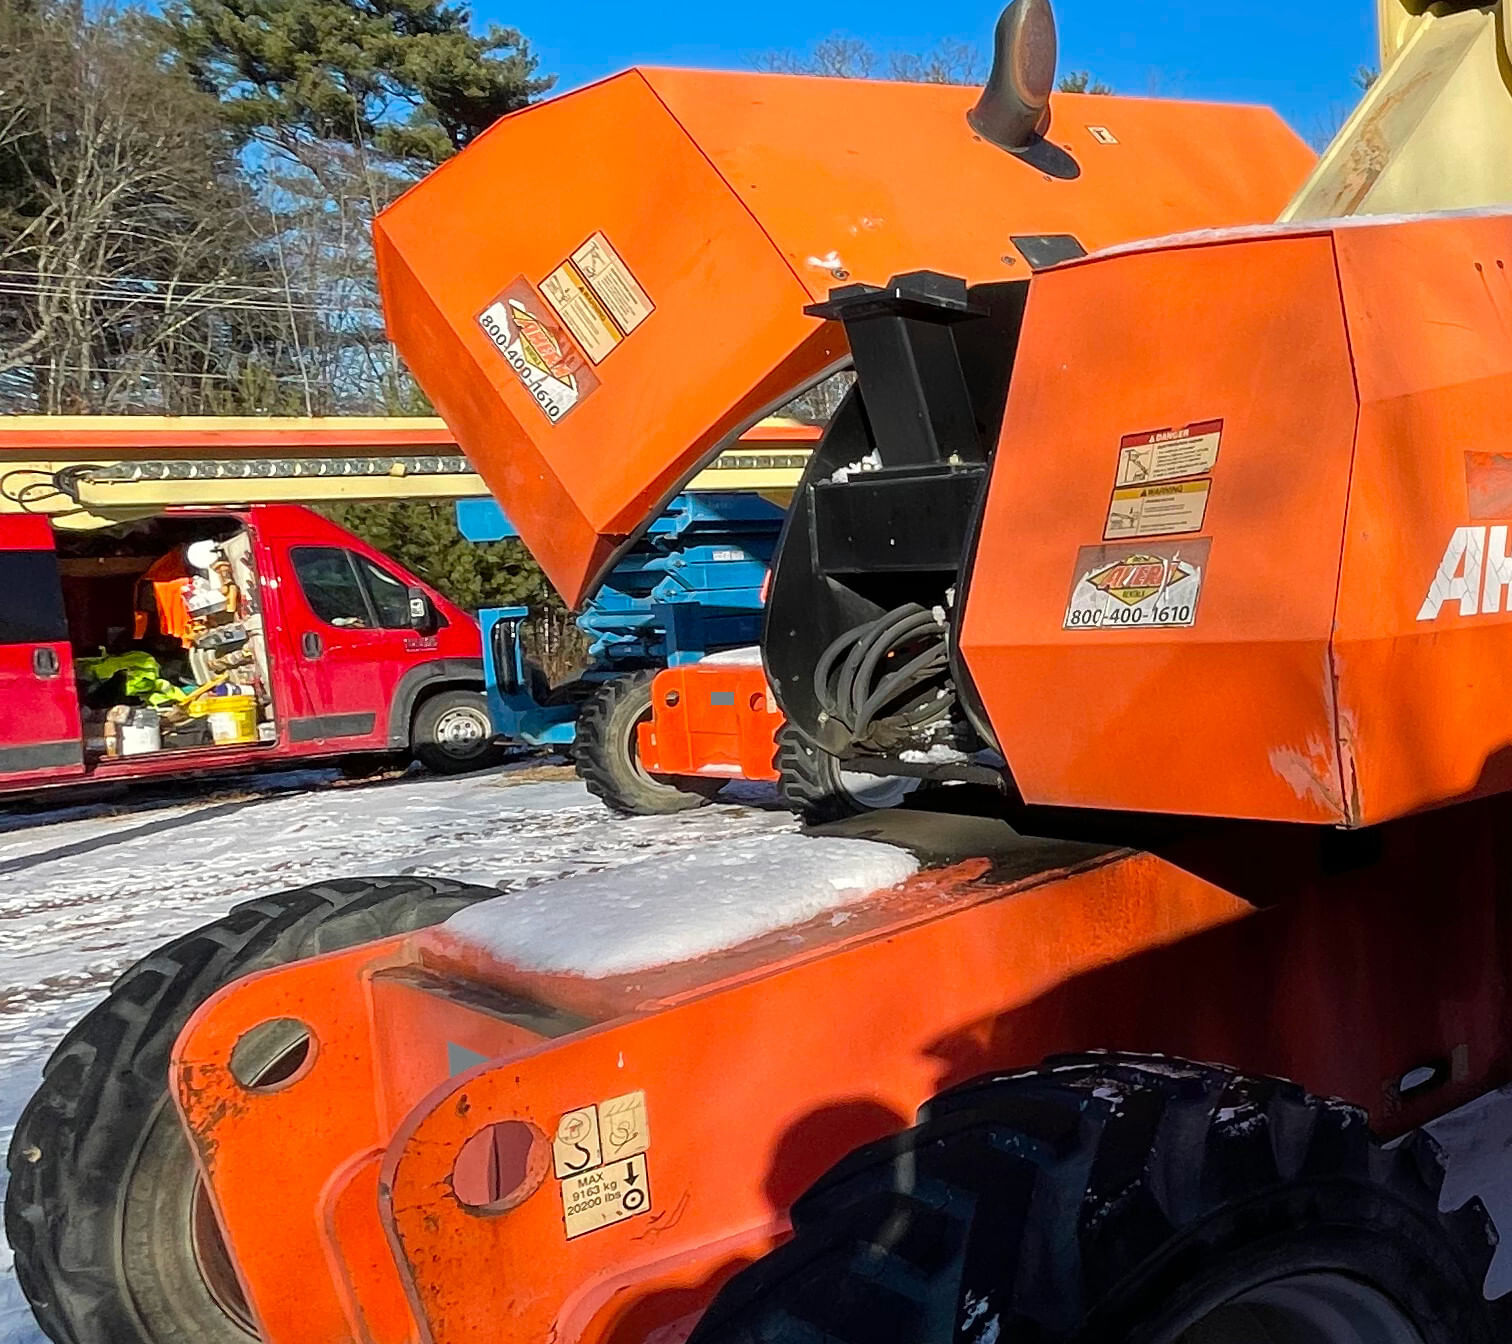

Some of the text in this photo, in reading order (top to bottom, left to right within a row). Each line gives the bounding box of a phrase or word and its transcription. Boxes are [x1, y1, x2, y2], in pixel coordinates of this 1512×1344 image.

[481, 314, 561, 419] 800-400-1610
[1070, 605, 1190, 625] 800-400-1610
[577, 1171, 604, 1188] MAX
[572, 1180, 617, 1202] 9163 kg
[567, 1191, 622, 1216] 20200 lbs
